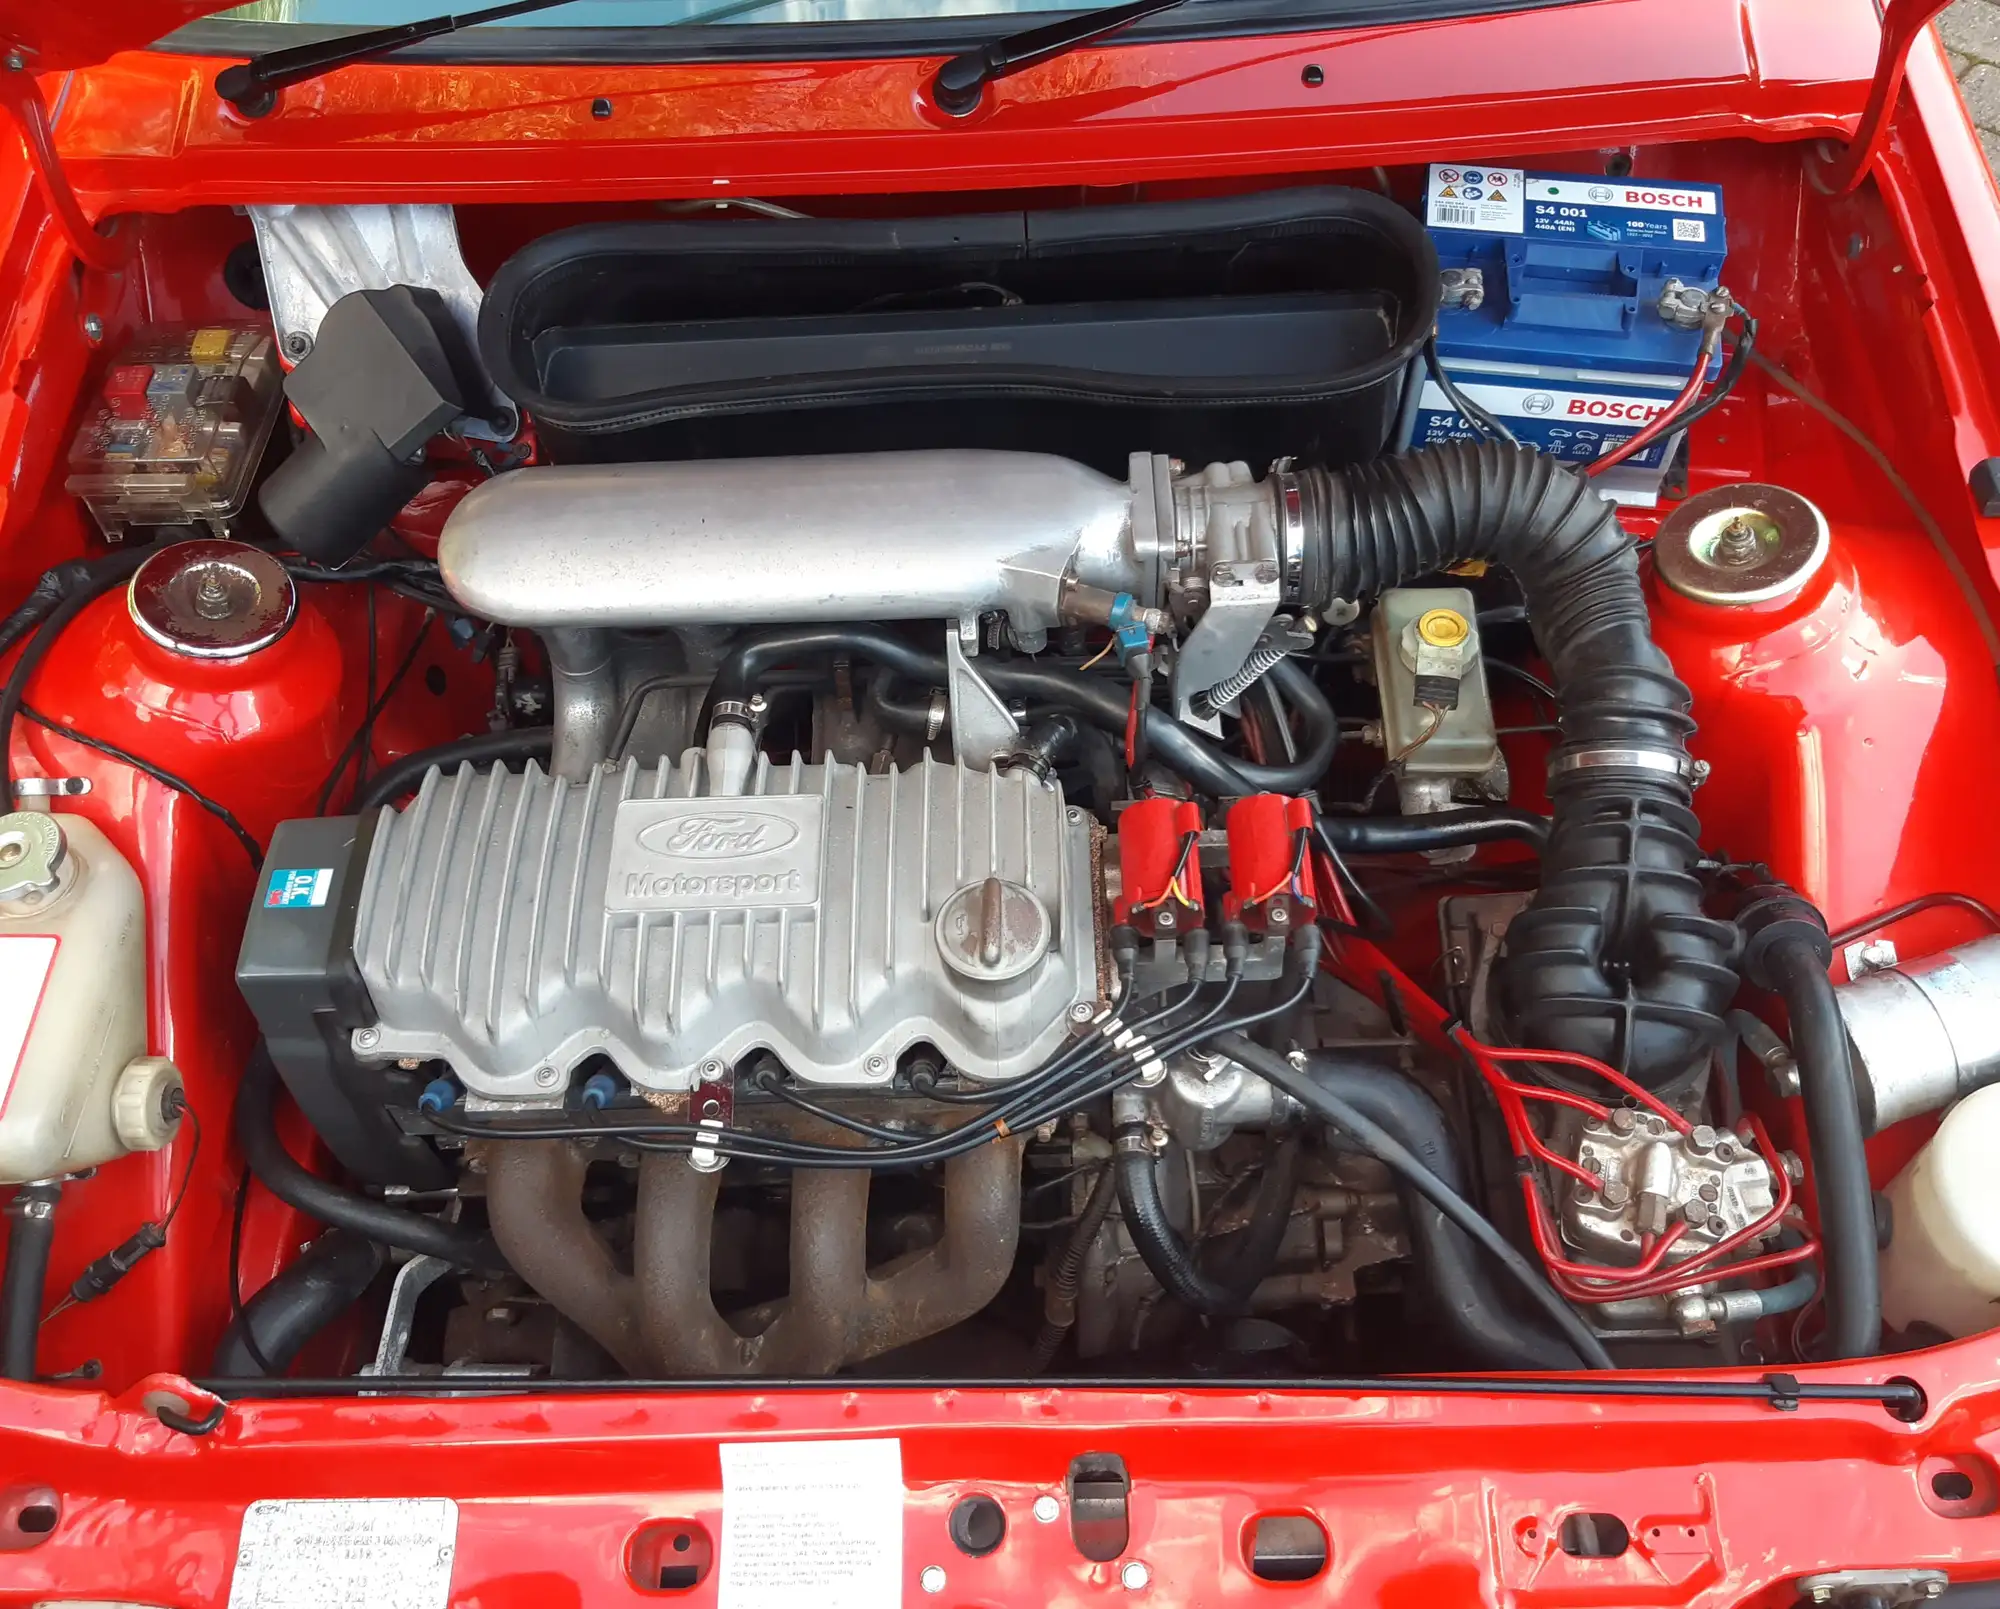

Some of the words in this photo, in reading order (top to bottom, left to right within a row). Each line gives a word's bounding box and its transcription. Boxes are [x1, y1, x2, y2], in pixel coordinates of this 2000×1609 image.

[1625, 191, 1703, 208] BOSCH
[1535, 205, 1556, 215] S4
[1559, 207, 1588, 218] 001
[1645, 222, 1668, 230] Years
[1567, 399, 1665, 421] BOSCH
[1429, 416, 1453, 428] S4
[1426, 429, 1445, 437] 12V
[666, 816, 769, 853] Ford
[626, 869, 801, 899] Motorsport
